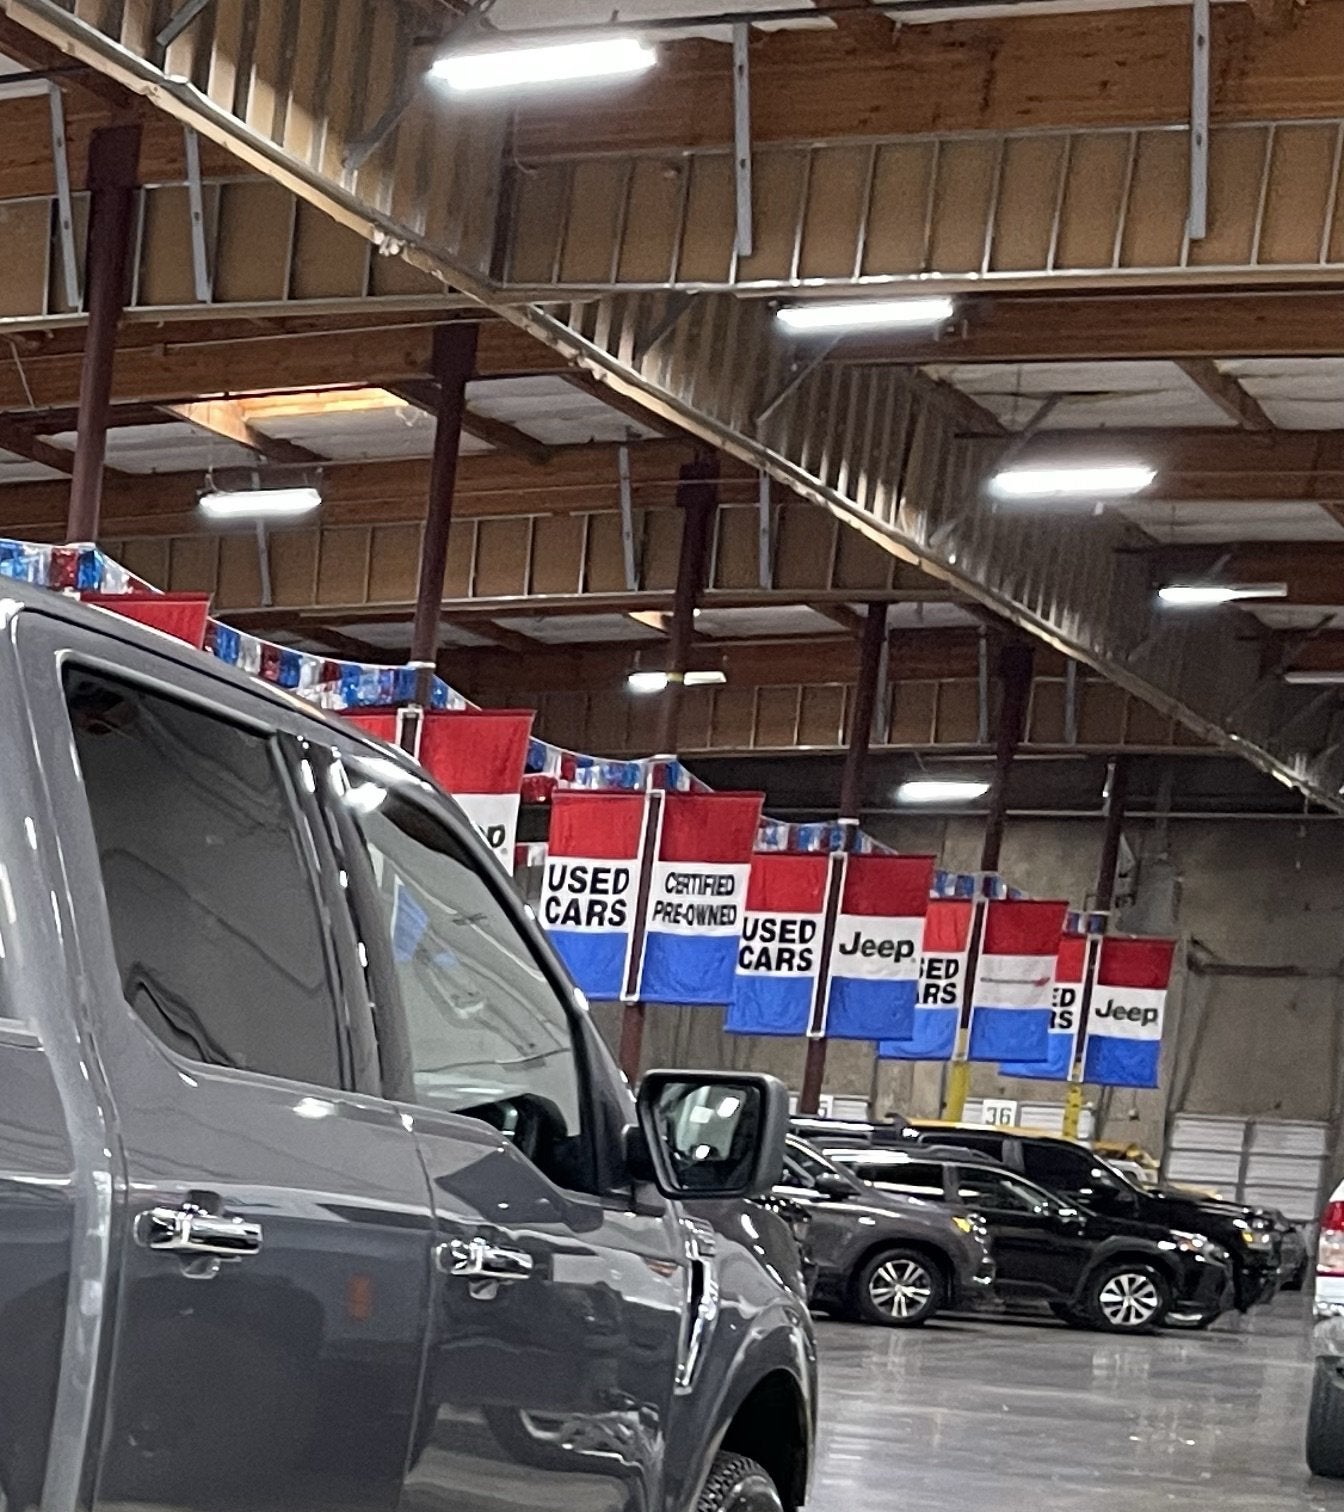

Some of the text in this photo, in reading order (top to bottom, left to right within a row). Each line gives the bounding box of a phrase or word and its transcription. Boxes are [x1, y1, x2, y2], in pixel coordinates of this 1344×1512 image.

[547, 863, 630, 895] USED
[664, 871, 735, 897] CERTIFIED
[544, 895, 627, 926] CARS
[652, 900, 738, 926] PRE-OWNED
[741, 917, 817, 944] USED
[738, 945, 814, 972] CARS
[838, 931, 914, 963] Jeep
[1094, 998, 1159, 1027] Jeep
[985, 1107, 1012, 1126] 36
